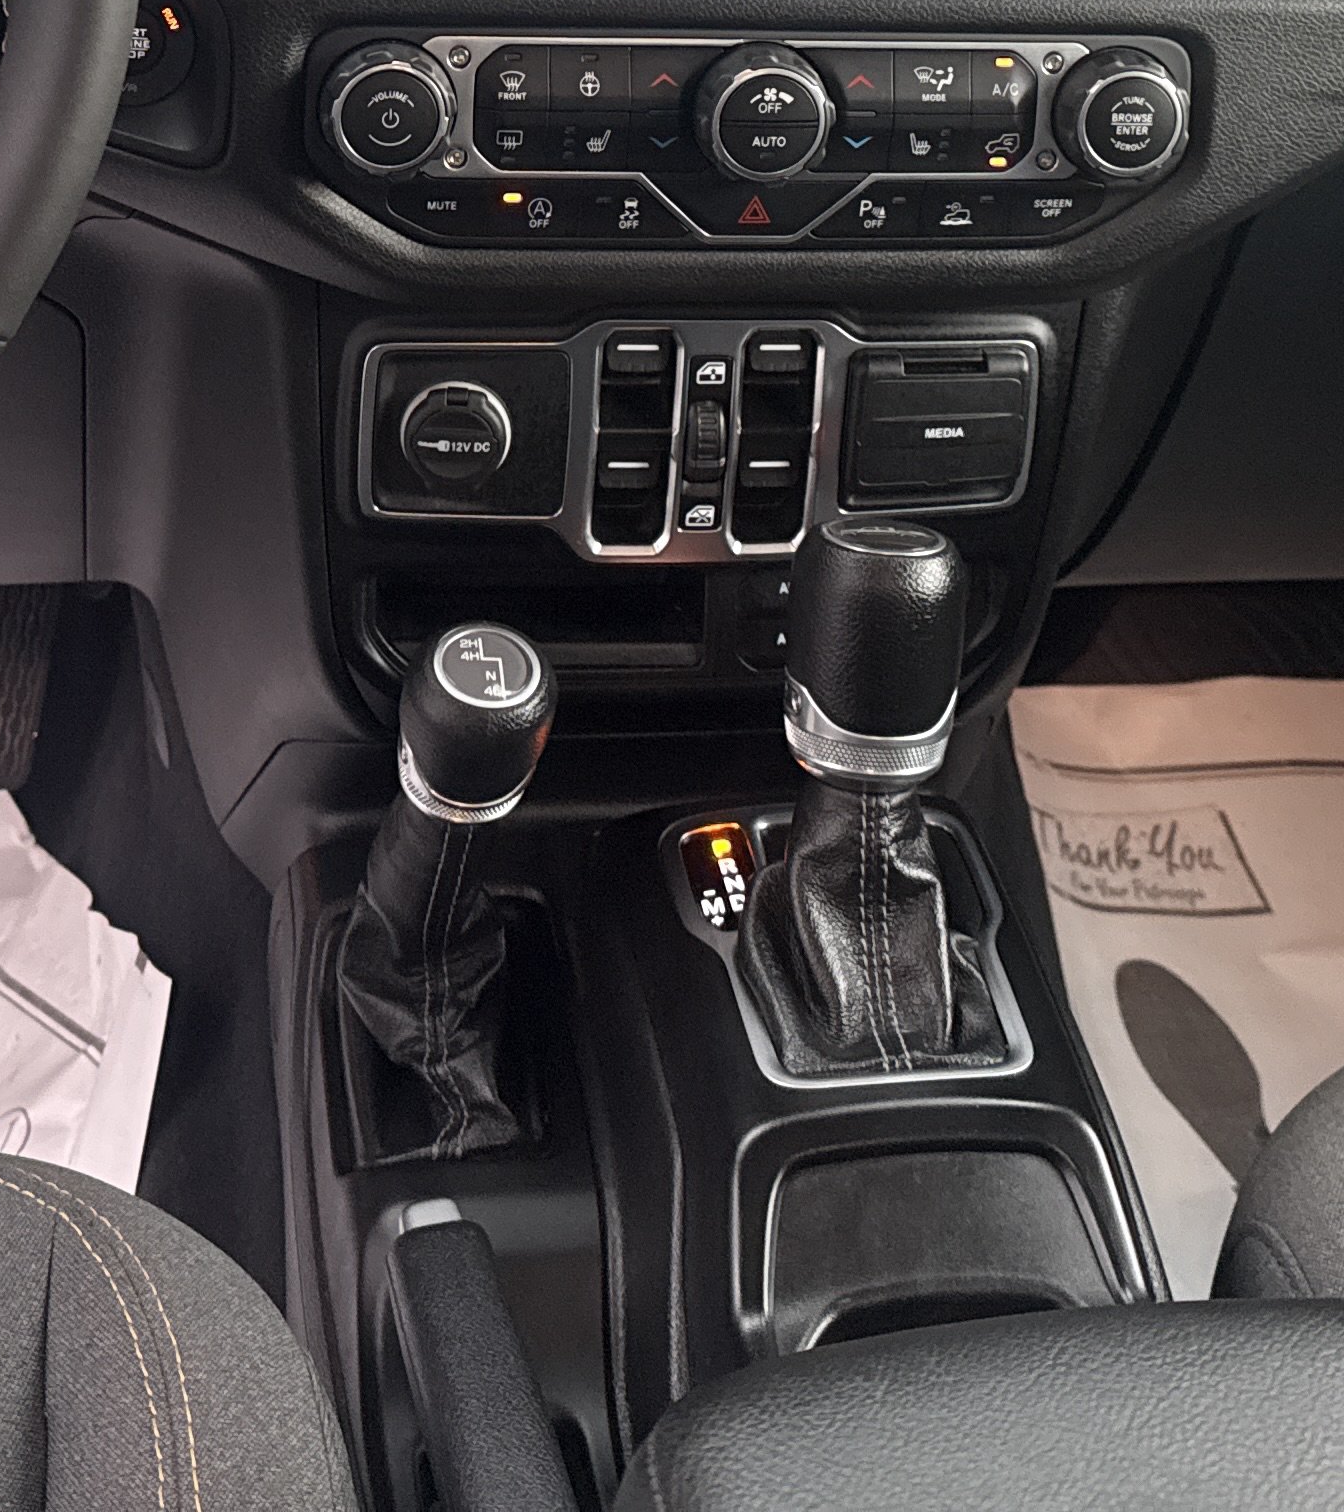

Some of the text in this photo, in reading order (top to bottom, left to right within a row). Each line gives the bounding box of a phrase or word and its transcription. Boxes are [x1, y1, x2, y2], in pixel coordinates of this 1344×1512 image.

[161, 6, 180, 32] RUN
[498, 91, 527, 101] FRONT
[992, 83, 1020, 98] A/C
[371, 90, 409, 103] VOLUME
[922, 93, 947, 103] MODE
[1122, 96, 1145, 106] TUNE
[758, 102, 783, 115] OFF
[1111, 113, 1153, 123] BROWSE
[1116, 126, 1149, 136] ENTER
[752, 135, 787, 148] AUTO
[1114, 141, 1147, 152] SCROLL
[427, 200, 457, 211] MUTE
[1034, 198, 1073, 209] SCREEN
[1041, 208, 1062, 218] OFF
[528, 218, 551, 229] OFF
[618, 219, 640, 230] OFF
[863, 219, 885, 229] OFF
[924, 426, 965, 439] MEDIA
[451, 440, 491, 454] 12V DC
[459, 638, 478, 649] 2H
[460, 651, 480, 662] 4H
[485, 670, 496, 681] N
[1031, 805, 1225, 877] Thank You
[718, 857, 738, 876] R
[723, 874, 746, 894] N
[700, 896, 726, 917] M
